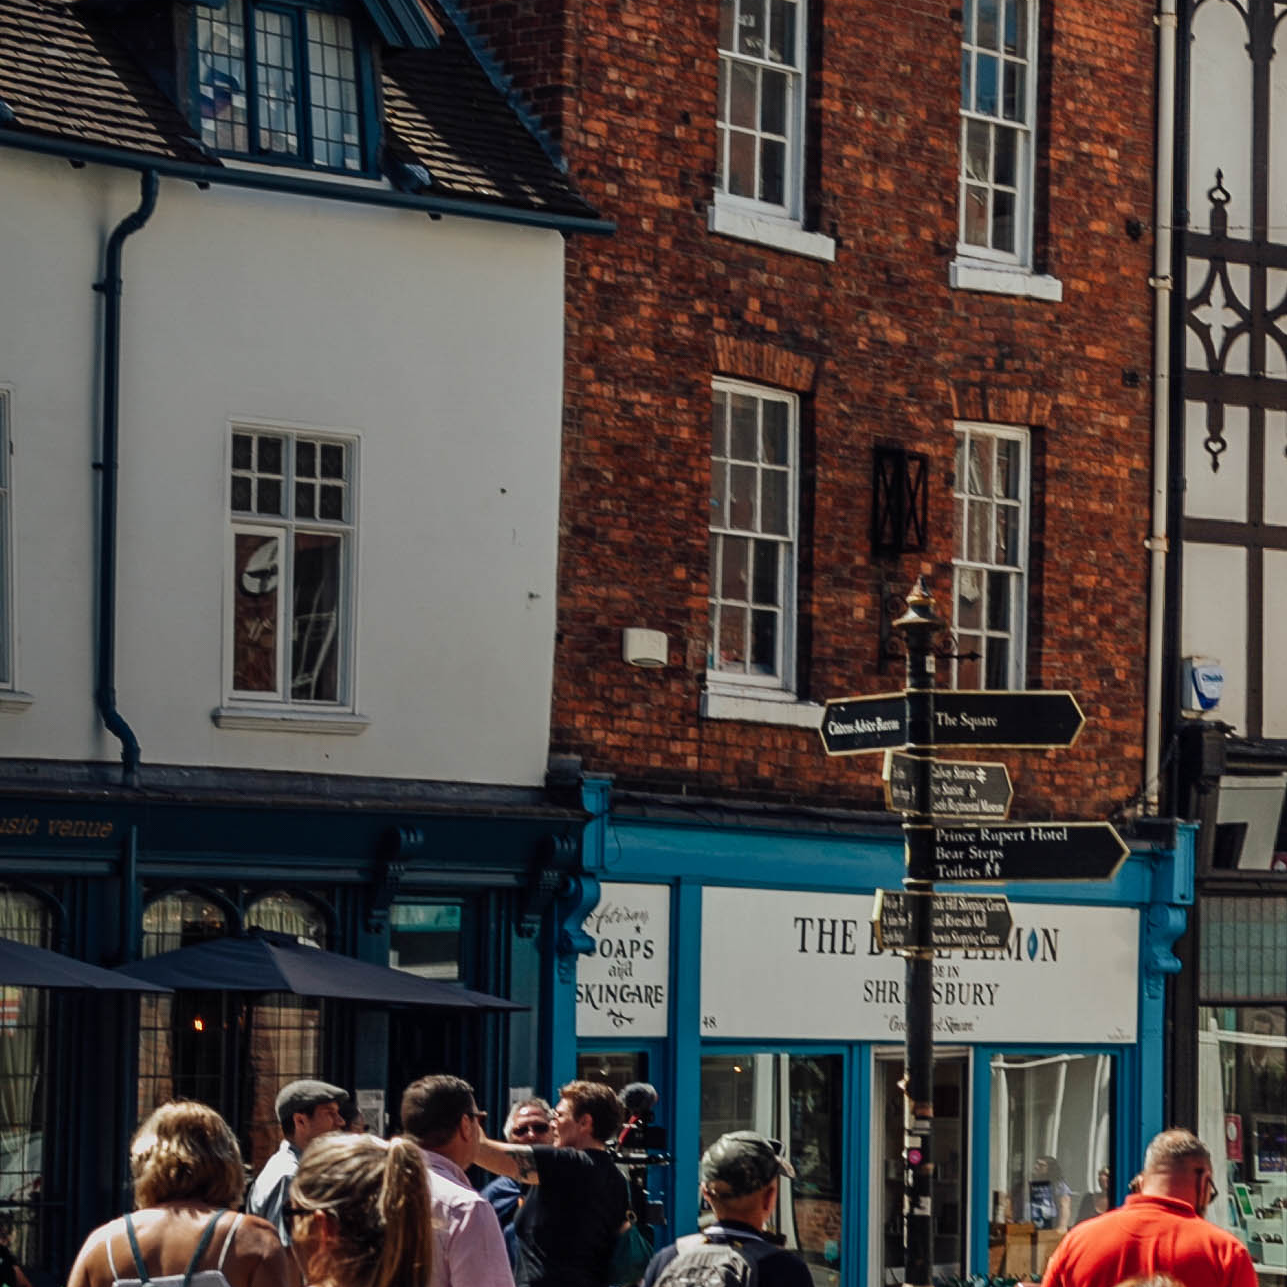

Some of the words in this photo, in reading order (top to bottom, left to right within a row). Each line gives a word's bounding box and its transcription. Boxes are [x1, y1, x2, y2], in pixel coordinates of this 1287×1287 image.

[936, 712, 958, 727] The
[960, 713, 998, 732] Square
[935, 828, 976, 842] Prince
[980, 828, 1026, 845] Rupert
[1030, 827, 1068, 841] Hotel
[935, 846, 965, 860] Bear
[969, 845, 1004, 863] Steps
[936, 864, 980, 878] Toilets
[794, 916, 858, 955] THE
[600, 938, 655, 960] OAPS
[608, 961, 633, 979] and
[947, 966, 960, 979] IN
[576, 983, 665, 1010] SKINCARE
[863, 979, 1000, 1006] SHRSBURY
